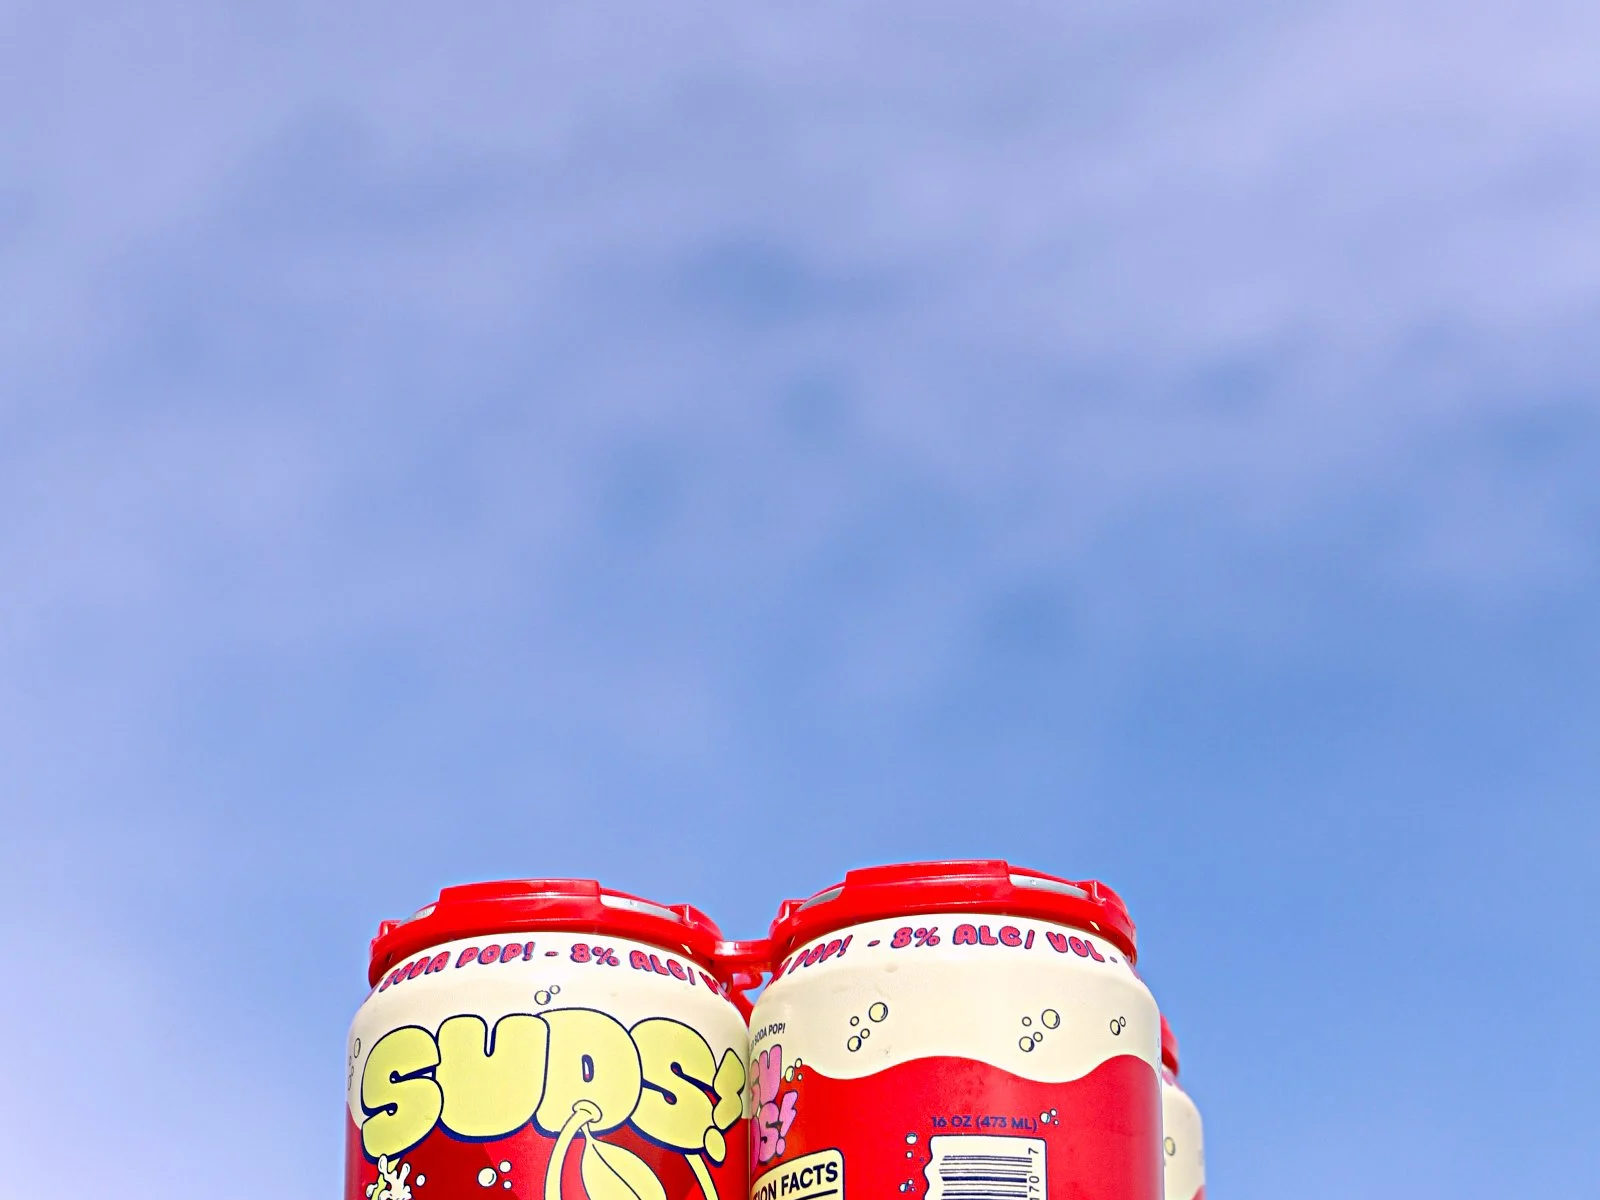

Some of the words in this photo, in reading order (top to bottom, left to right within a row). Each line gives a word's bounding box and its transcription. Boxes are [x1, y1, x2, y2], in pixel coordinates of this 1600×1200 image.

[455, 941, 535, 968] POP!
[571, 943, 620, 967] 8%
[788, 935, 853, 974] POP!
[891, 927, 940, 948] 8%
[1046, 931, 1105, 963] VOL
[768, 1023, 786, 1036] POP!
[361, 1006, 746, 1166] SUDS!
[931, 1116, 947, 1128] 16
[951, 1116, 972, 1127] OZ
[976, 1115, 1007, 1129] (473
[1011, 1117, 1038, 1132] ML)
[1028, 1147, 1039, 1155] 7
[781, 1162, 838, 1196] FACTS
